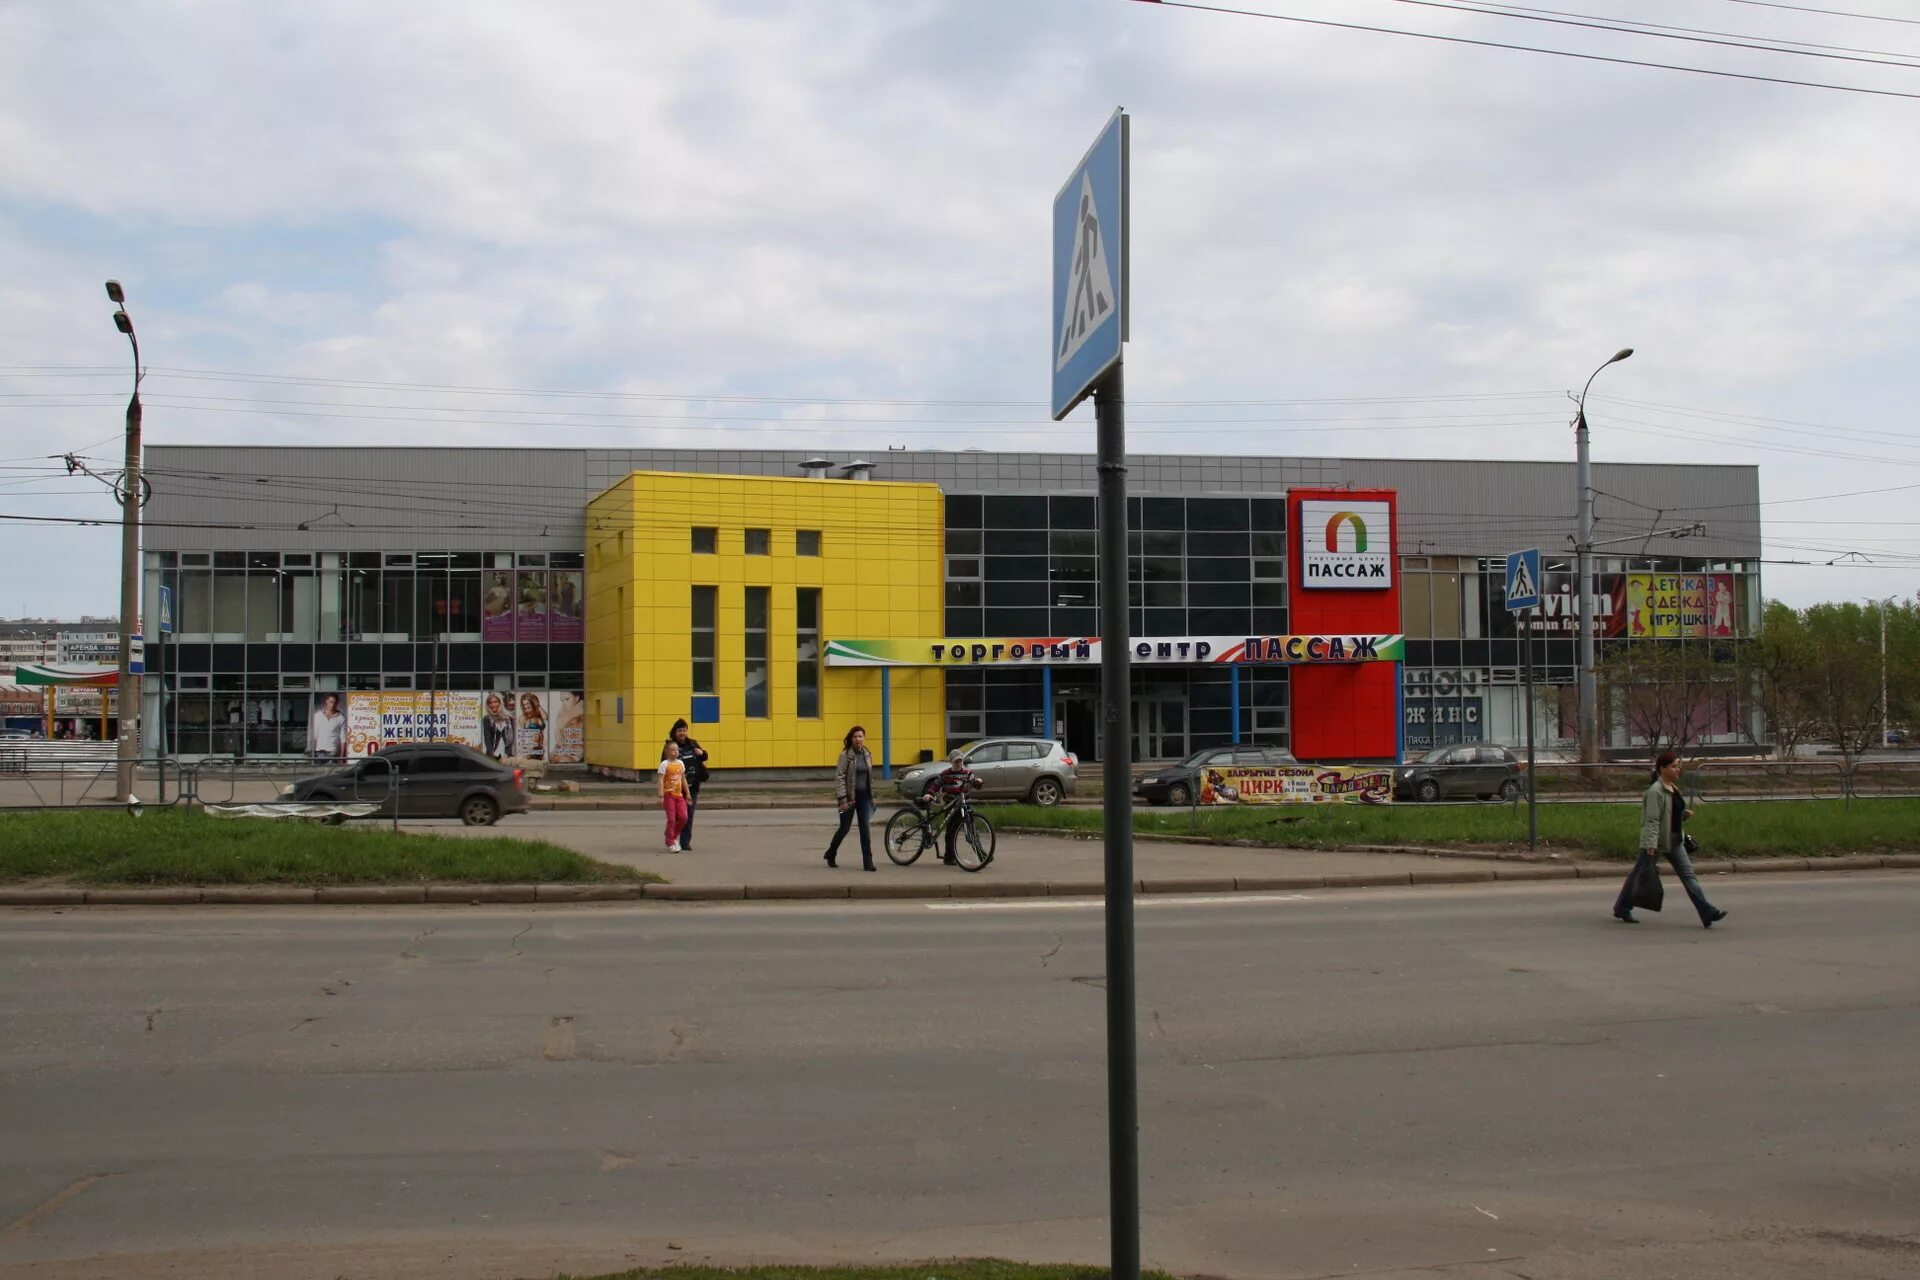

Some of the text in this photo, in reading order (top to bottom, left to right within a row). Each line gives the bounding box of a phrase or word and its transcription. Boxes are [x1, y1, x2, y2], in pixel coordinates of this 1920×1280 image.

[1309, 564, 1385, 577] ПАССАЖ
[1647, 577, 1715, 591] ДЕТСКАЯ
[1645, 596, 1717, 608] ОДЕЖДА
[1650, 614, 1712, 626] ИГРУШКИ
[932, 637, 1379, 662] торговый ентр ПАССАЖ
[383, 714, 447, 725] МУЖСКАЯ
[384, 727, 447, 738] ЖЕНСКАЯ
[1278, 769, 1314, 777] СЕЗОНА
[1240, 780, 1284, 796] ЦИРК
